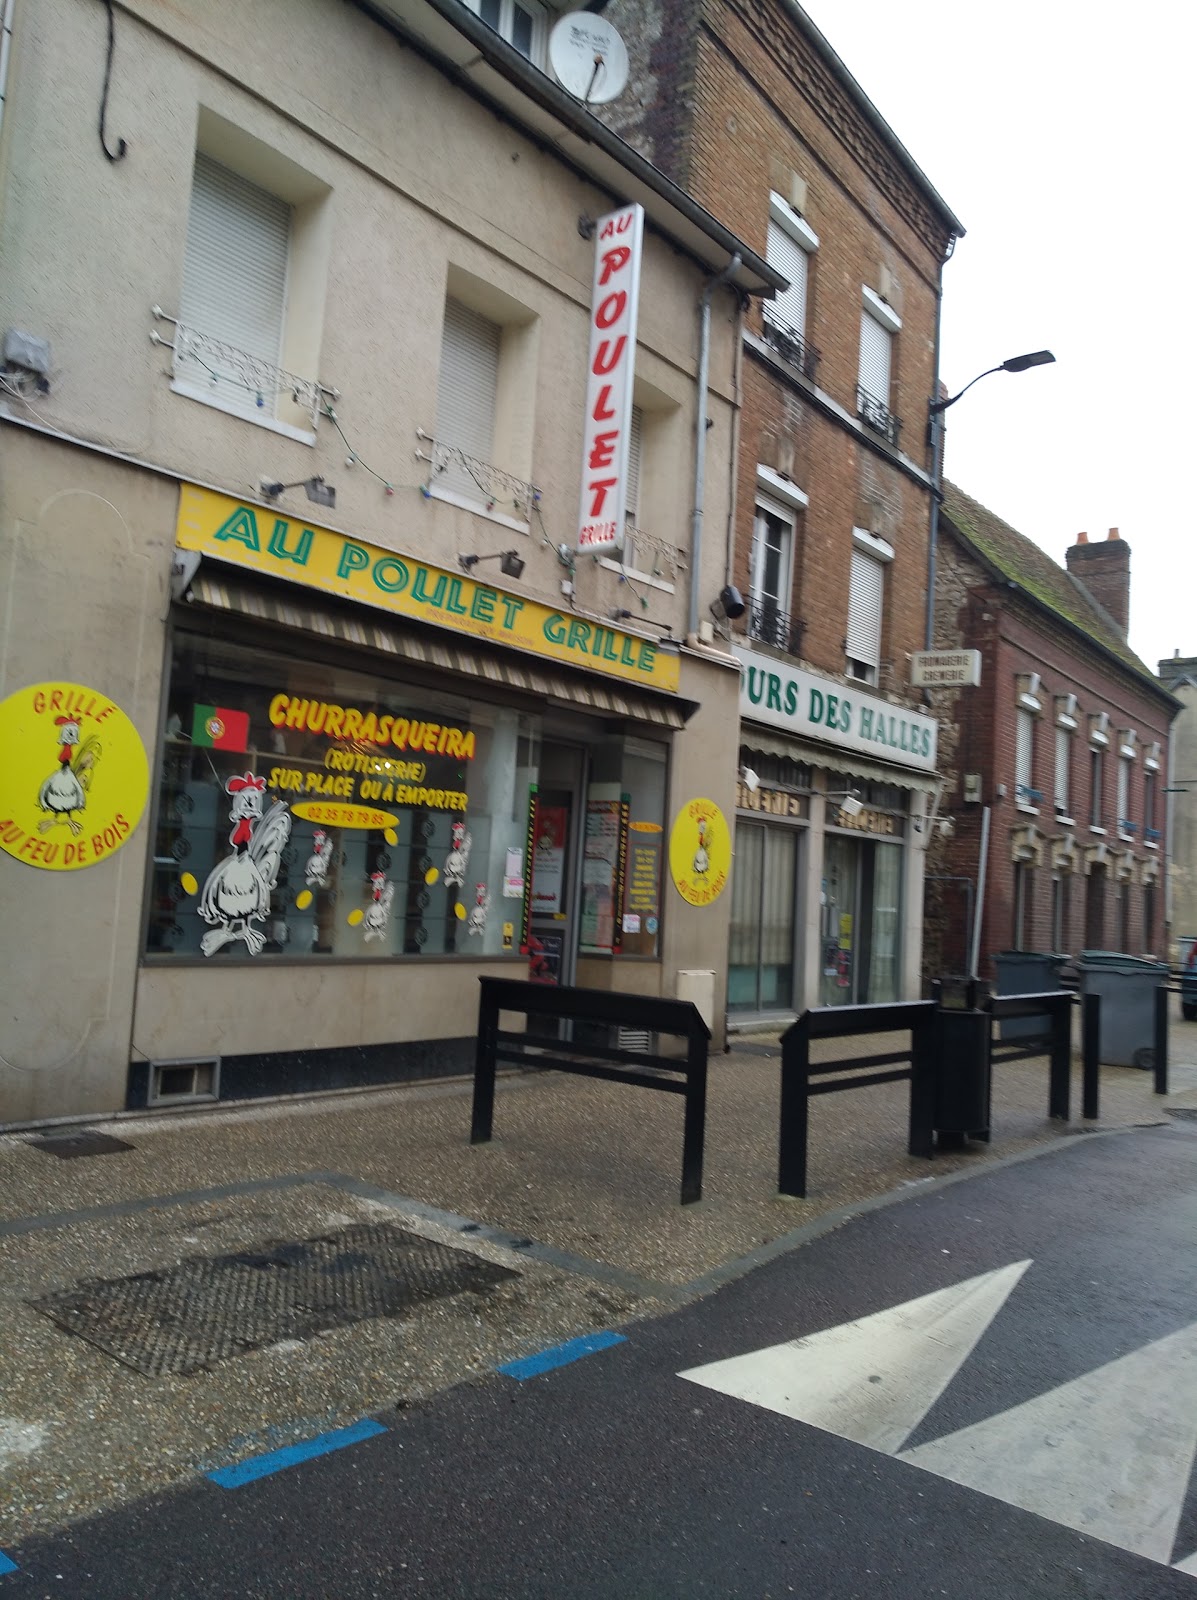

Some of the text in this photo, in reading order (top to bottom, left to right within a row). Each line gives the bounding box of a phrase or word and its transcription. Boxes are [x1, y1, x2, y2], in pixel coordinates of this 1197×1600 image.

[598, 212, 633, 240] AU
[587, 246, 632, 517] POULET
[213, 506, 316, 566] AU
[336, 541, 524, 630] POULET
[543, 613, 658, 673] GRILLE
[268, 693, 476, 760] CHURRASQUEIRA
[738, 665, 932, 758] URS DES HALLES
[268, 767, 303, 792] SUR
[305, 771, 355, 797] PLACE
[360, 779, 383, 801] OU
[395, 785, 469, 811] EMPORTER
[0, 813, 129, 865] AU FEU DE BOIS
